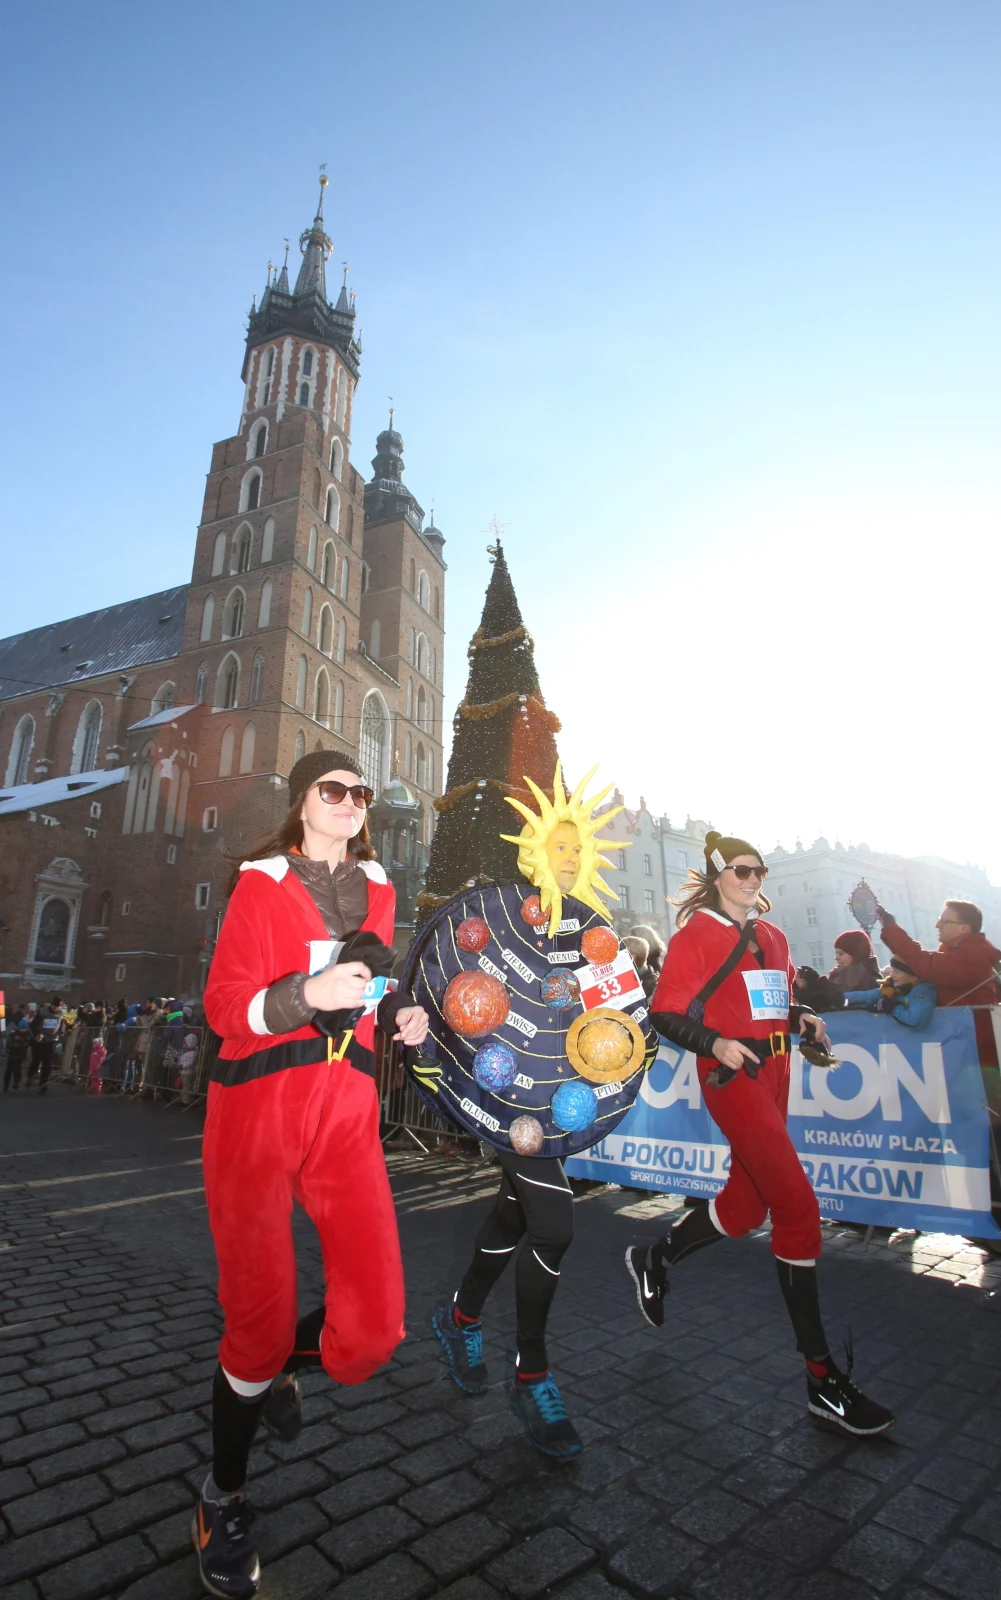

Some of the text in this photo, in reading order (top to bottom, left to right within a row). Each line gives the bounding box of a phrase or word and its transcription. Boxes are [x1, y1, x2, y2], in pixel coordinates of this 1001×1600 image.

[480, 957, 506, 983] MARS
[503, 950, 533, 982] ZIEMIA
[549, 952, 578, 963] WENUS
[597, 977, 622, 999] 33
[762, 990, 785, 1006] 885
[507, 1012, 537, 1036] OWISZ
[516, 1075, 533, 1088] AN
[596, 1081, 621, 1098] PTUN
[462, 1099, 499, 1132] PLUTON
[804, 1129, 958, 1155] KRAKÓW PLAZA
[589, 1139, 614, 1161] AL.
[621, 1141, 715, 1174] POKOJU
[801, 1159, 923, 1200] RAKÓW
[630, 1170, 844, 1211] SPORT DLA WSZYSTKICH ORTU
